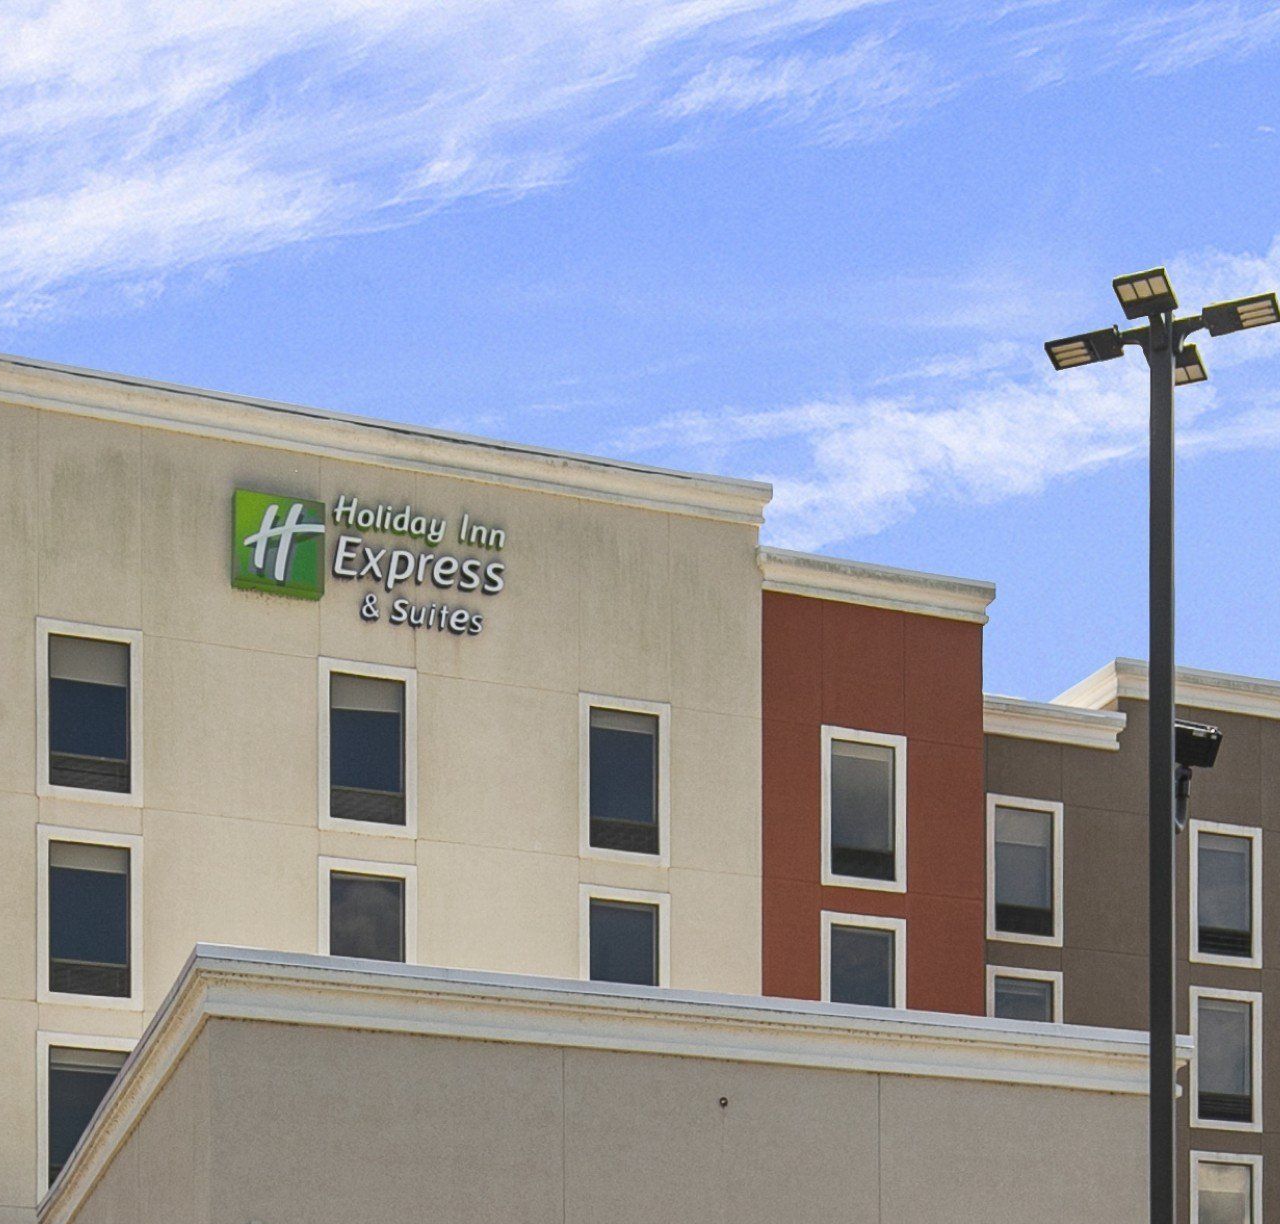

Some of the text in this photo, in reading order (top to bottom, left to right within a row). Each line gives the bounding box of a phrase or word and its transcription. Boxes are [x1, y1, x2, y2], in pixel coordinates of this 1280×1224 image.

[334, 495, 506, 548] Holiday Inn
[333, 535, 505, 593] Express
[361, 594, 484, 634] & Suites
